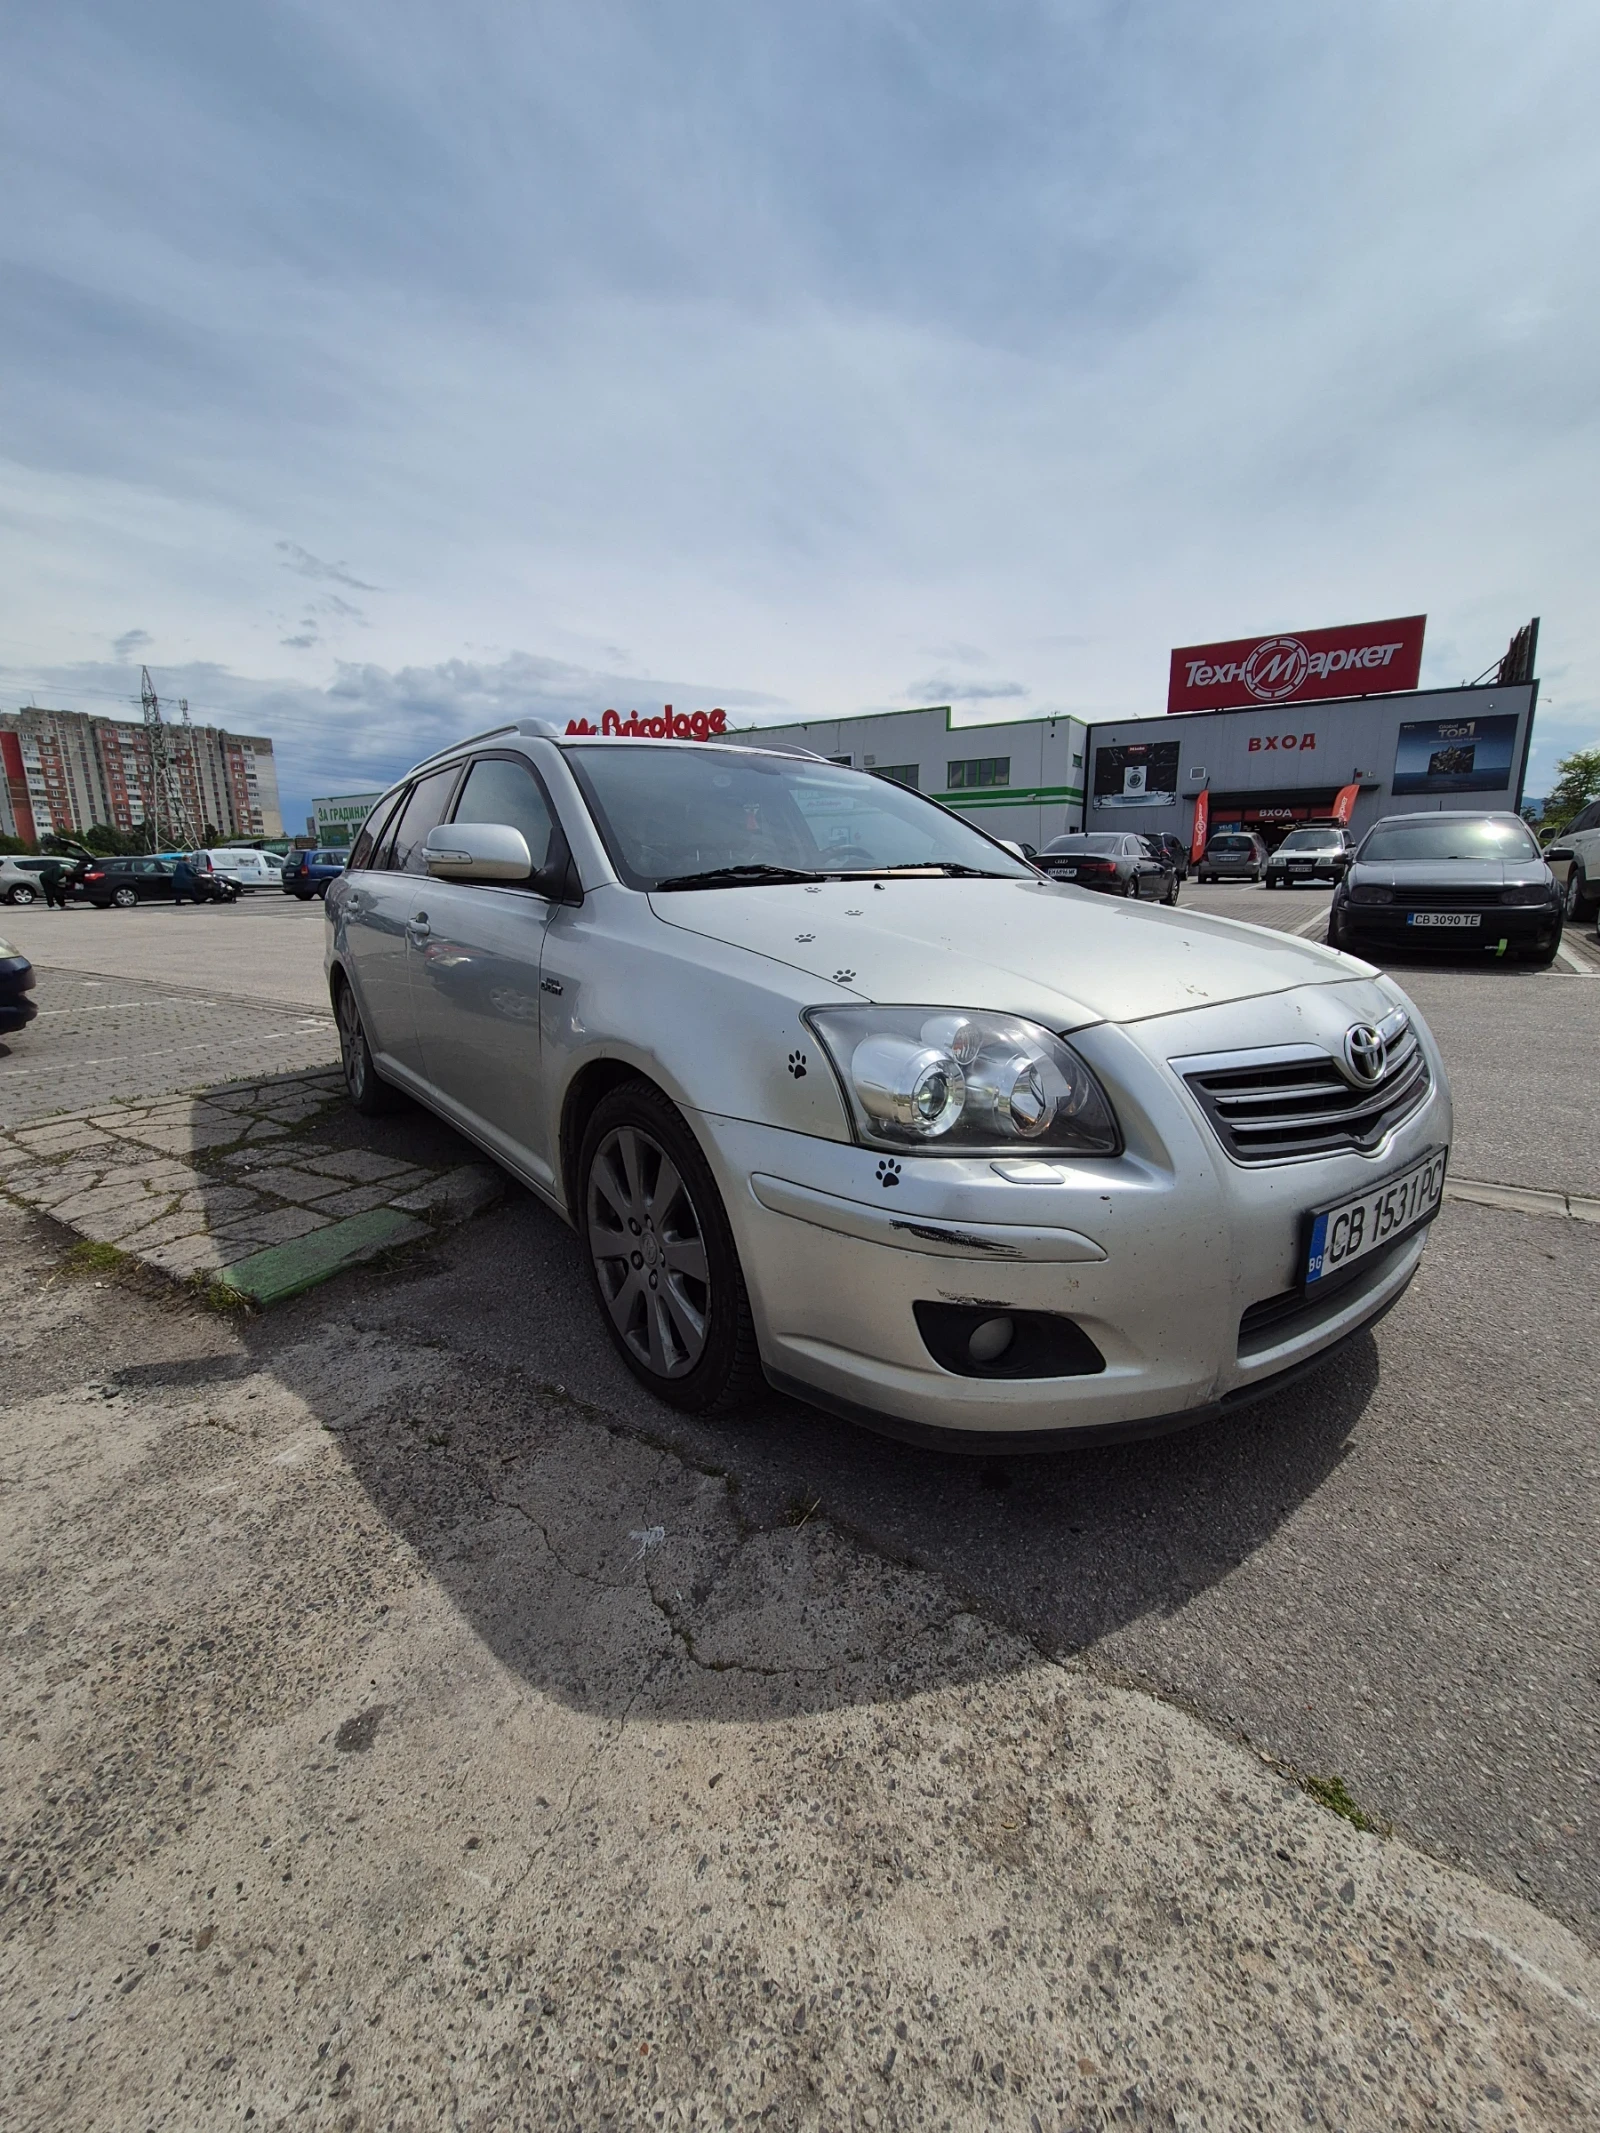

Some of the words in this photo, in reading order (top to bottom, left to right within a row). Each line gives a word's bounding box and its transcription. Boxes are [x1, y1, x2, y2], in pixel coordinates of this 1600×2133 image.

[602, 704, 727, 742] Bricolage
[1248, 732, 1316, 751] ВХОД
[318, 807, 328, 822] ЗА
[1259, 808, 1292, 818] ВХОД
[1415, 914, 1430, 925] CB
[1432, 915, 1461, 926] 3090
[1463, 915, 1479, 926] TE
[1308, 1254, 1323, 1273] BG
[1330, 1205, 1365, 1263] CB
[1372, 1175, 1419, 1242] 1531
[1416, 1158, 1442, 1213] PC
